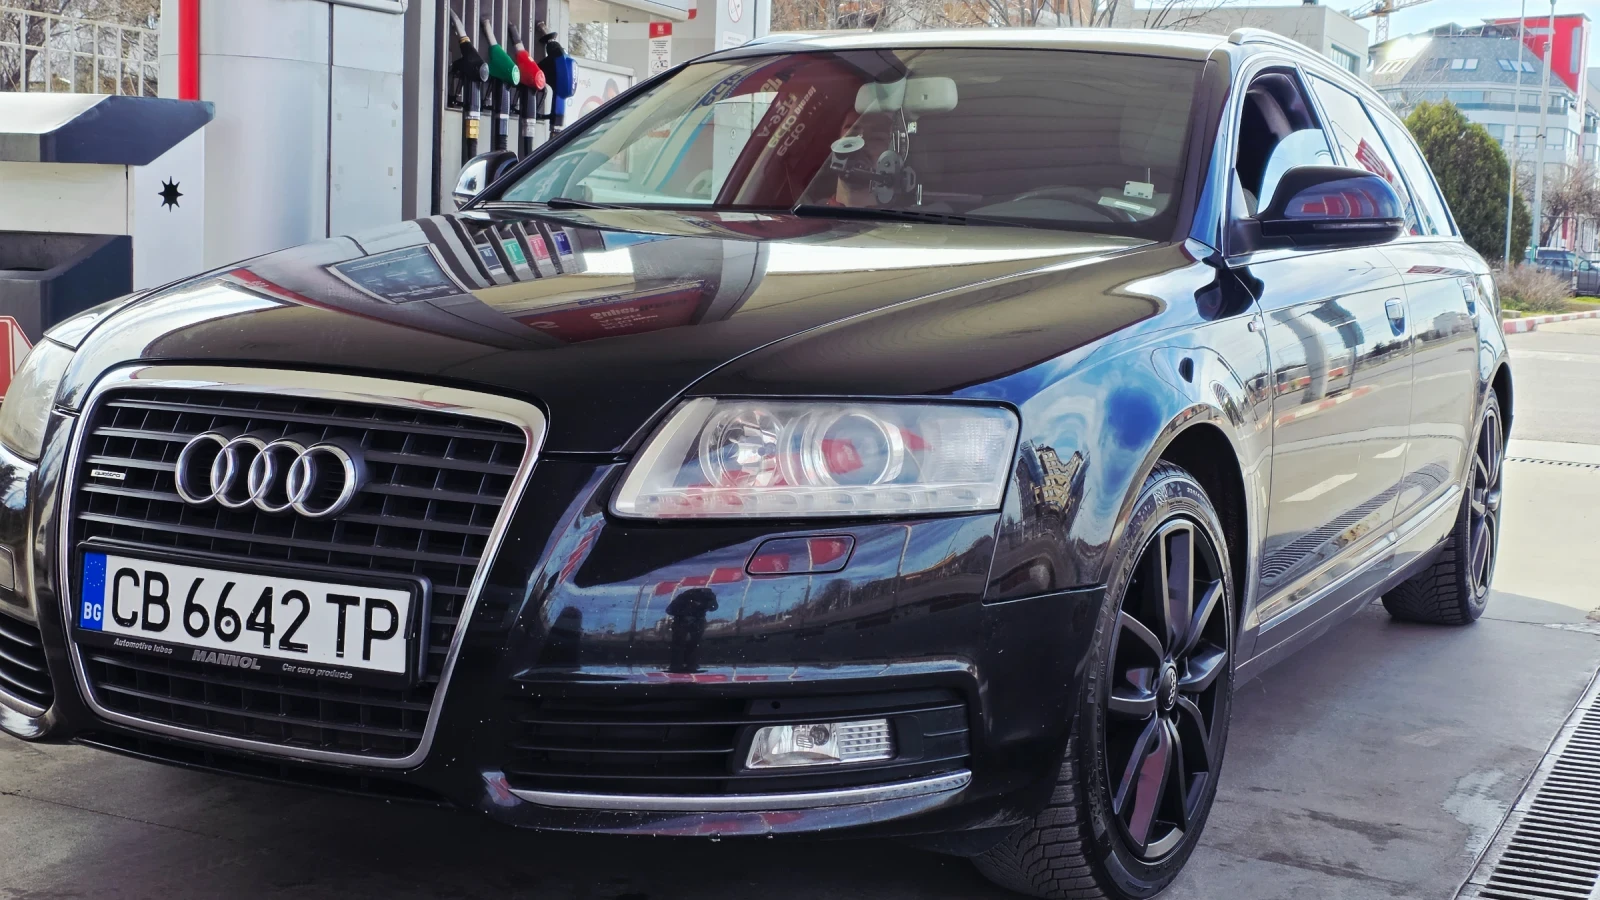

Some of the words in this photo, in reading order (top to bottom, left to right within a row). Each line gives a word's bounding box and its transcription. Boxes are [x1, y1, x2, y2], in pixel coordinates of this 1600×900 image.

[83, 602, 102, 621] BG
[112, 567, 171, 632] CB
[183, 577, 311, 653] 6642
[326, 593, 399, 661] TP
[114, 638, 153, 651] Automotive
[153, 644, 173, 655] lubes
[191, 650, 262, 670] MANNOL
[282, 663, 297, 673] Car
[297, 667, 316, 675] care
[315, 669, 353, 680] products
